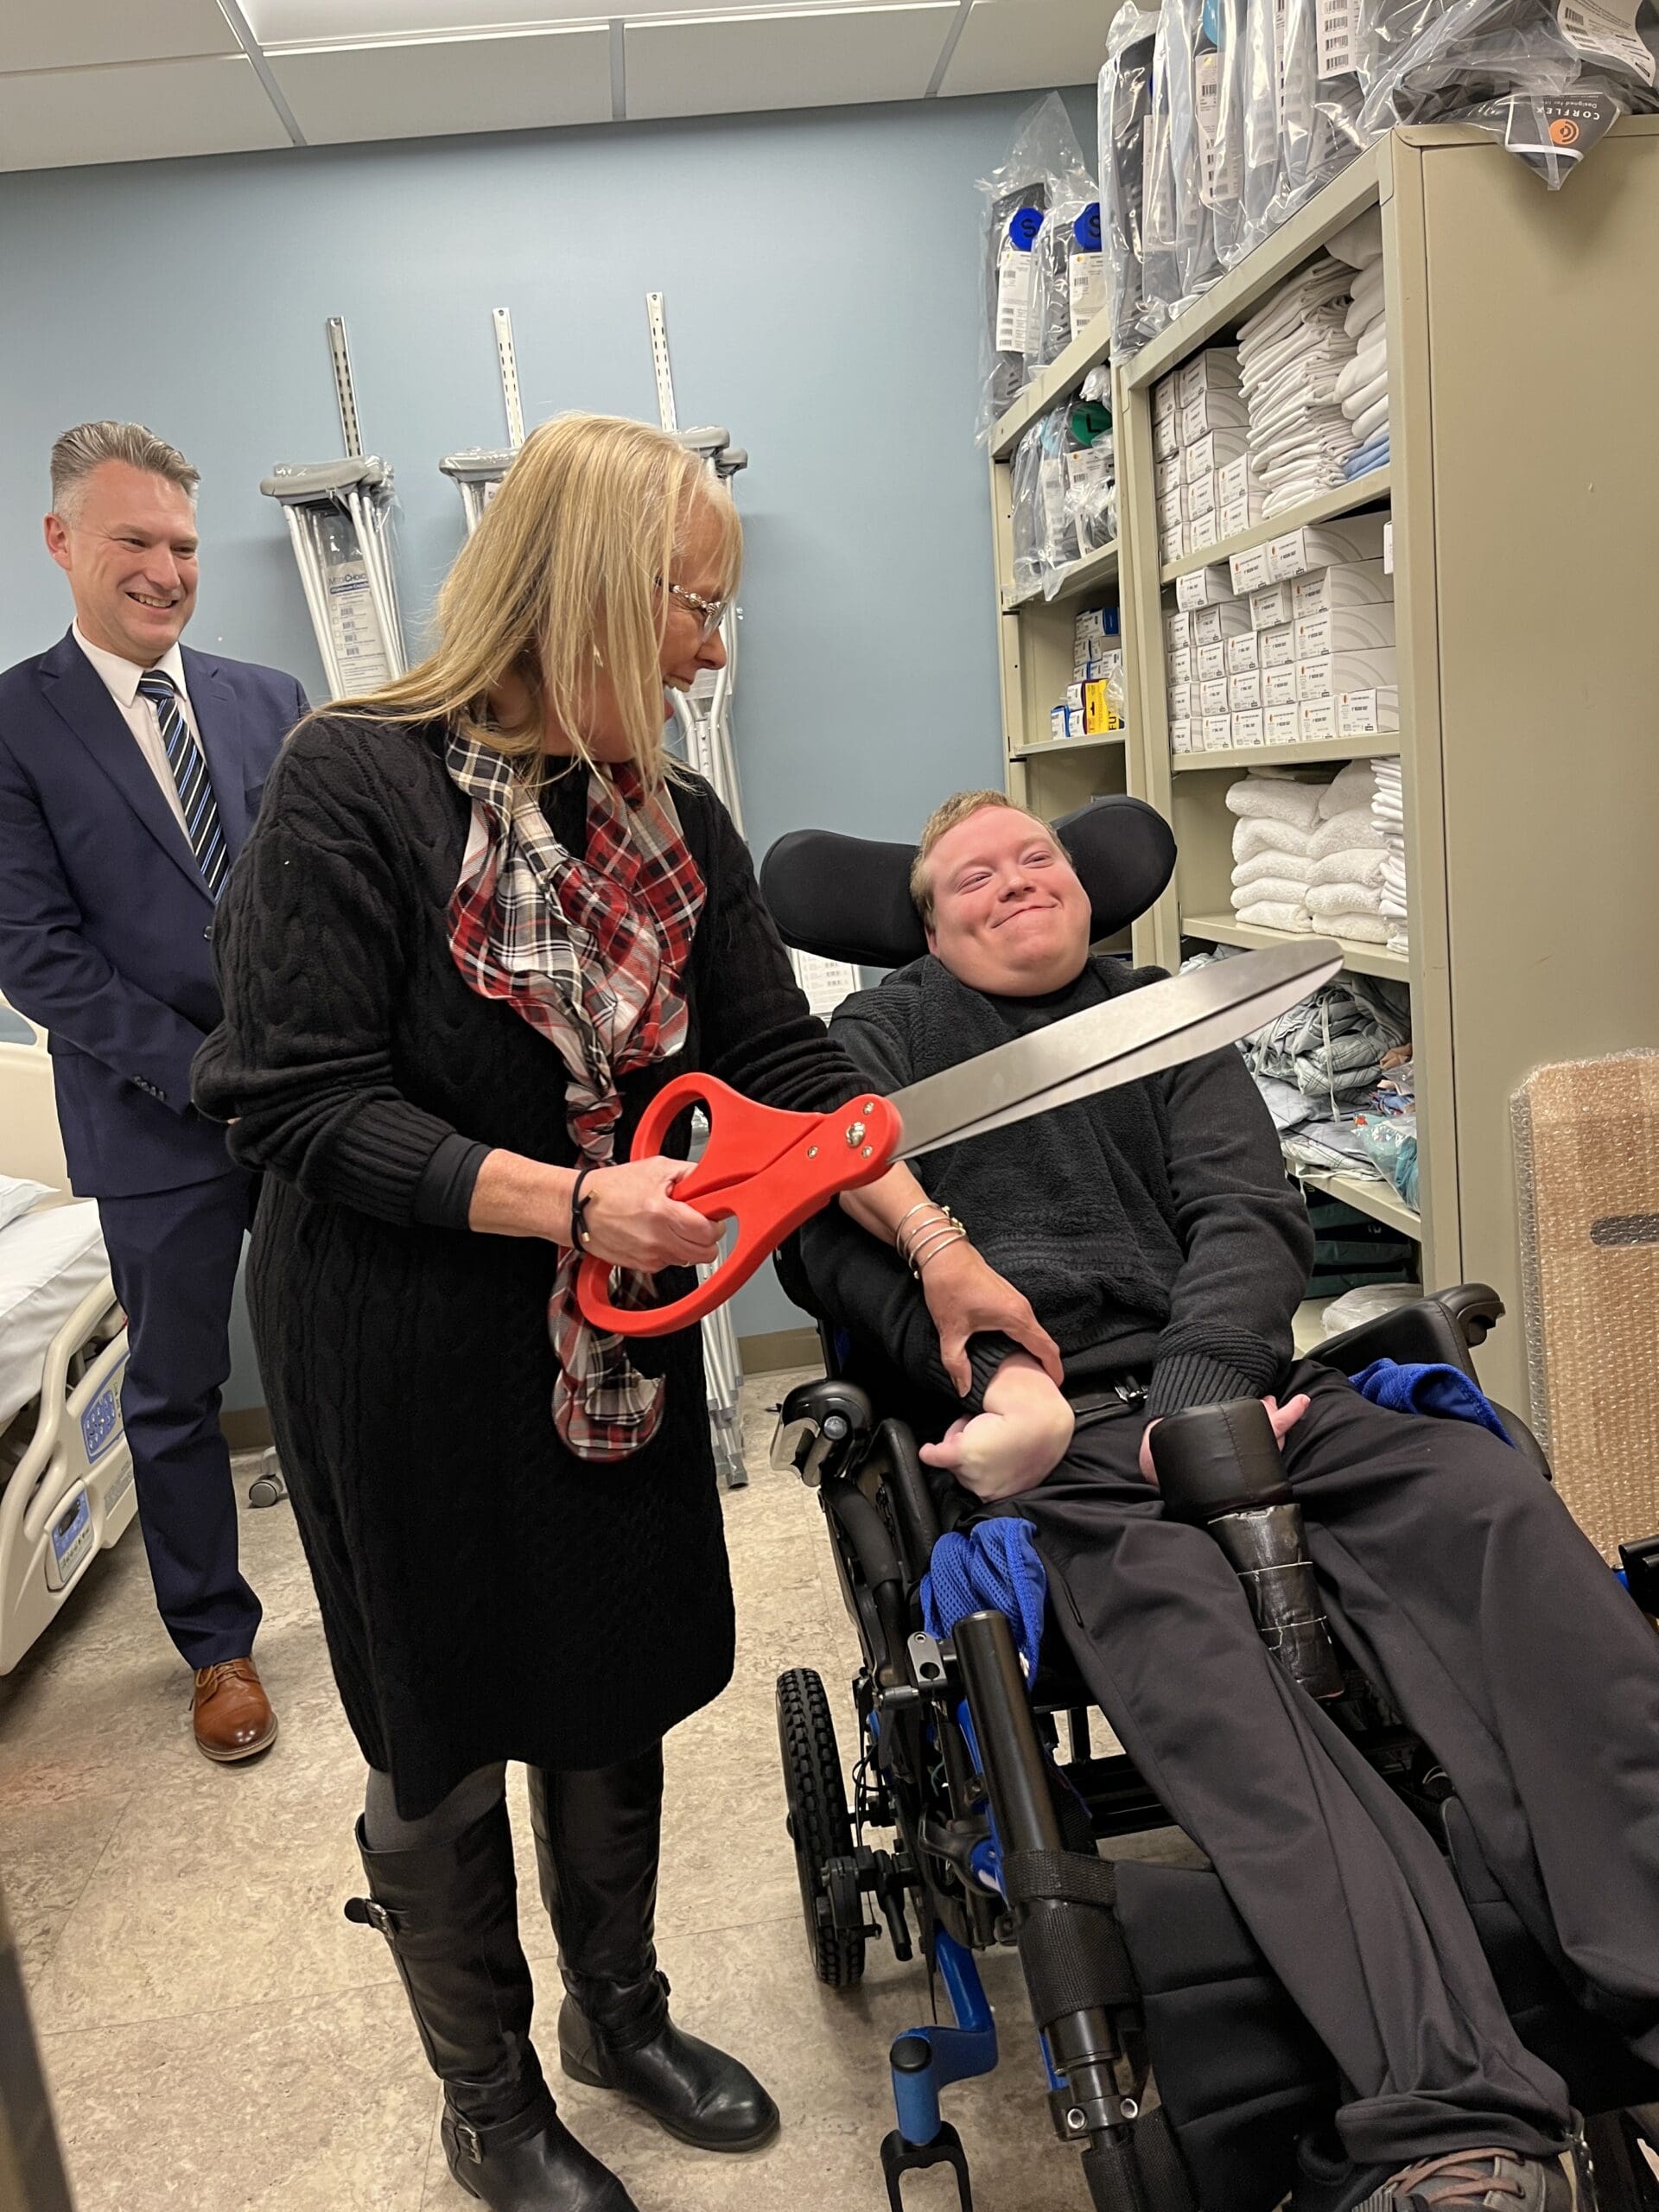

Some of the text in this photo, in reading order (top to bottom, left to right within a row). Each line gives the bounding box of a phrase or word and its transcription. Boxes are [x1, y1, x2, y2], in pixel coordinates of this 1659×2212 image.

[1535, 106, 1600, 120] CORFLEX
[1566, 100, 1598, 109] Designed
[1020, 218, 1037, 238] S
[1089, 215, 1101, 238] S
[1086, 414, 1103, 434] L
